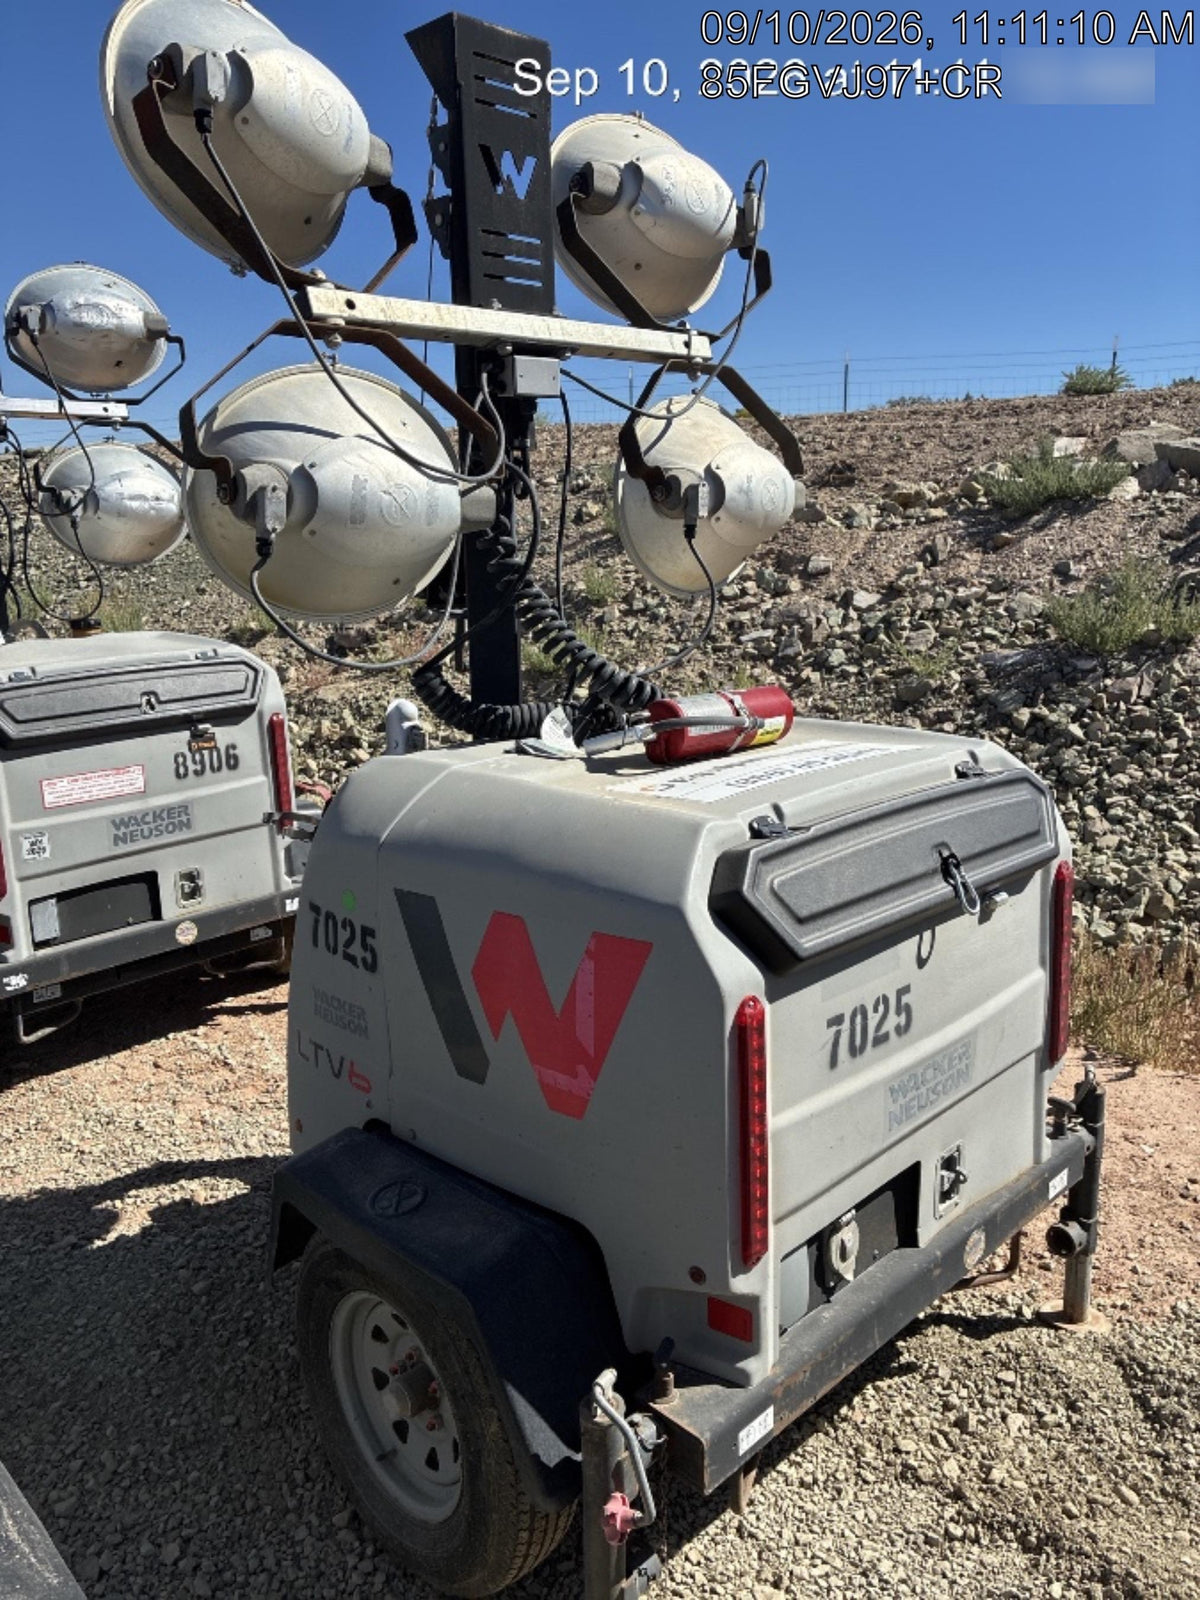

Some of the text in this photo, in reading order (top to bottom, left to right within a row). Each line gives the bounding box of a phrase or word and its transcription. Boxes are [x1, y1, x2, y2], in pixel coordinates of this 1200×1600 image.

[174, 743, 239, 780] 8906
[110, 804, 190, 832] WACKER
[112, 817, 193, 847] NEUSON
[309, 902, 378, 974] 7025
[312, 983, 367, 1020] WACKER
[313, 1001, 370, 1040] NEUSON
[826, 984, 913, 1070] 7025
[888, 1039, 972, 1105] WACKER
[888, 1062, 971, 1133] NEUSON
